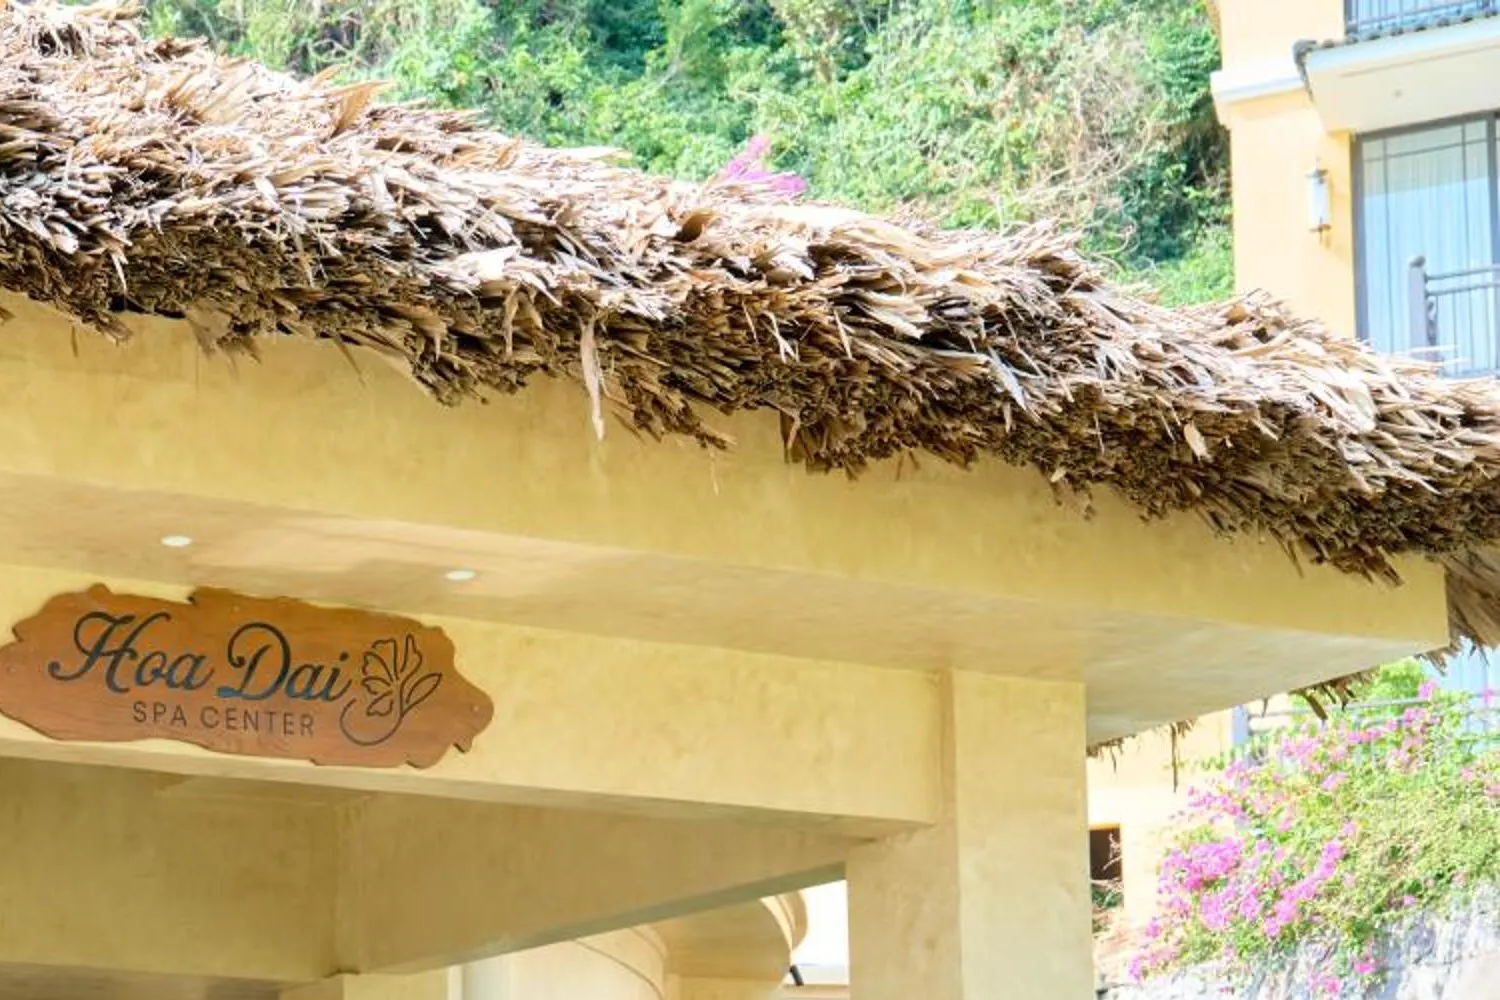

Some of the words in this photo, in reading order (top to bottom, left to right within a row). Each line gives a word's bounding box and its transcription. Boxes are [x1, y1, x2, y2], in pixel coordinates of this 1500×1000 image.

[48, 611, 214, 693] Hoa
[217, 622, 352, 701] Dai
[132, 700, 187, 727] SPA
[200, 705, 315, 737] CENTER
